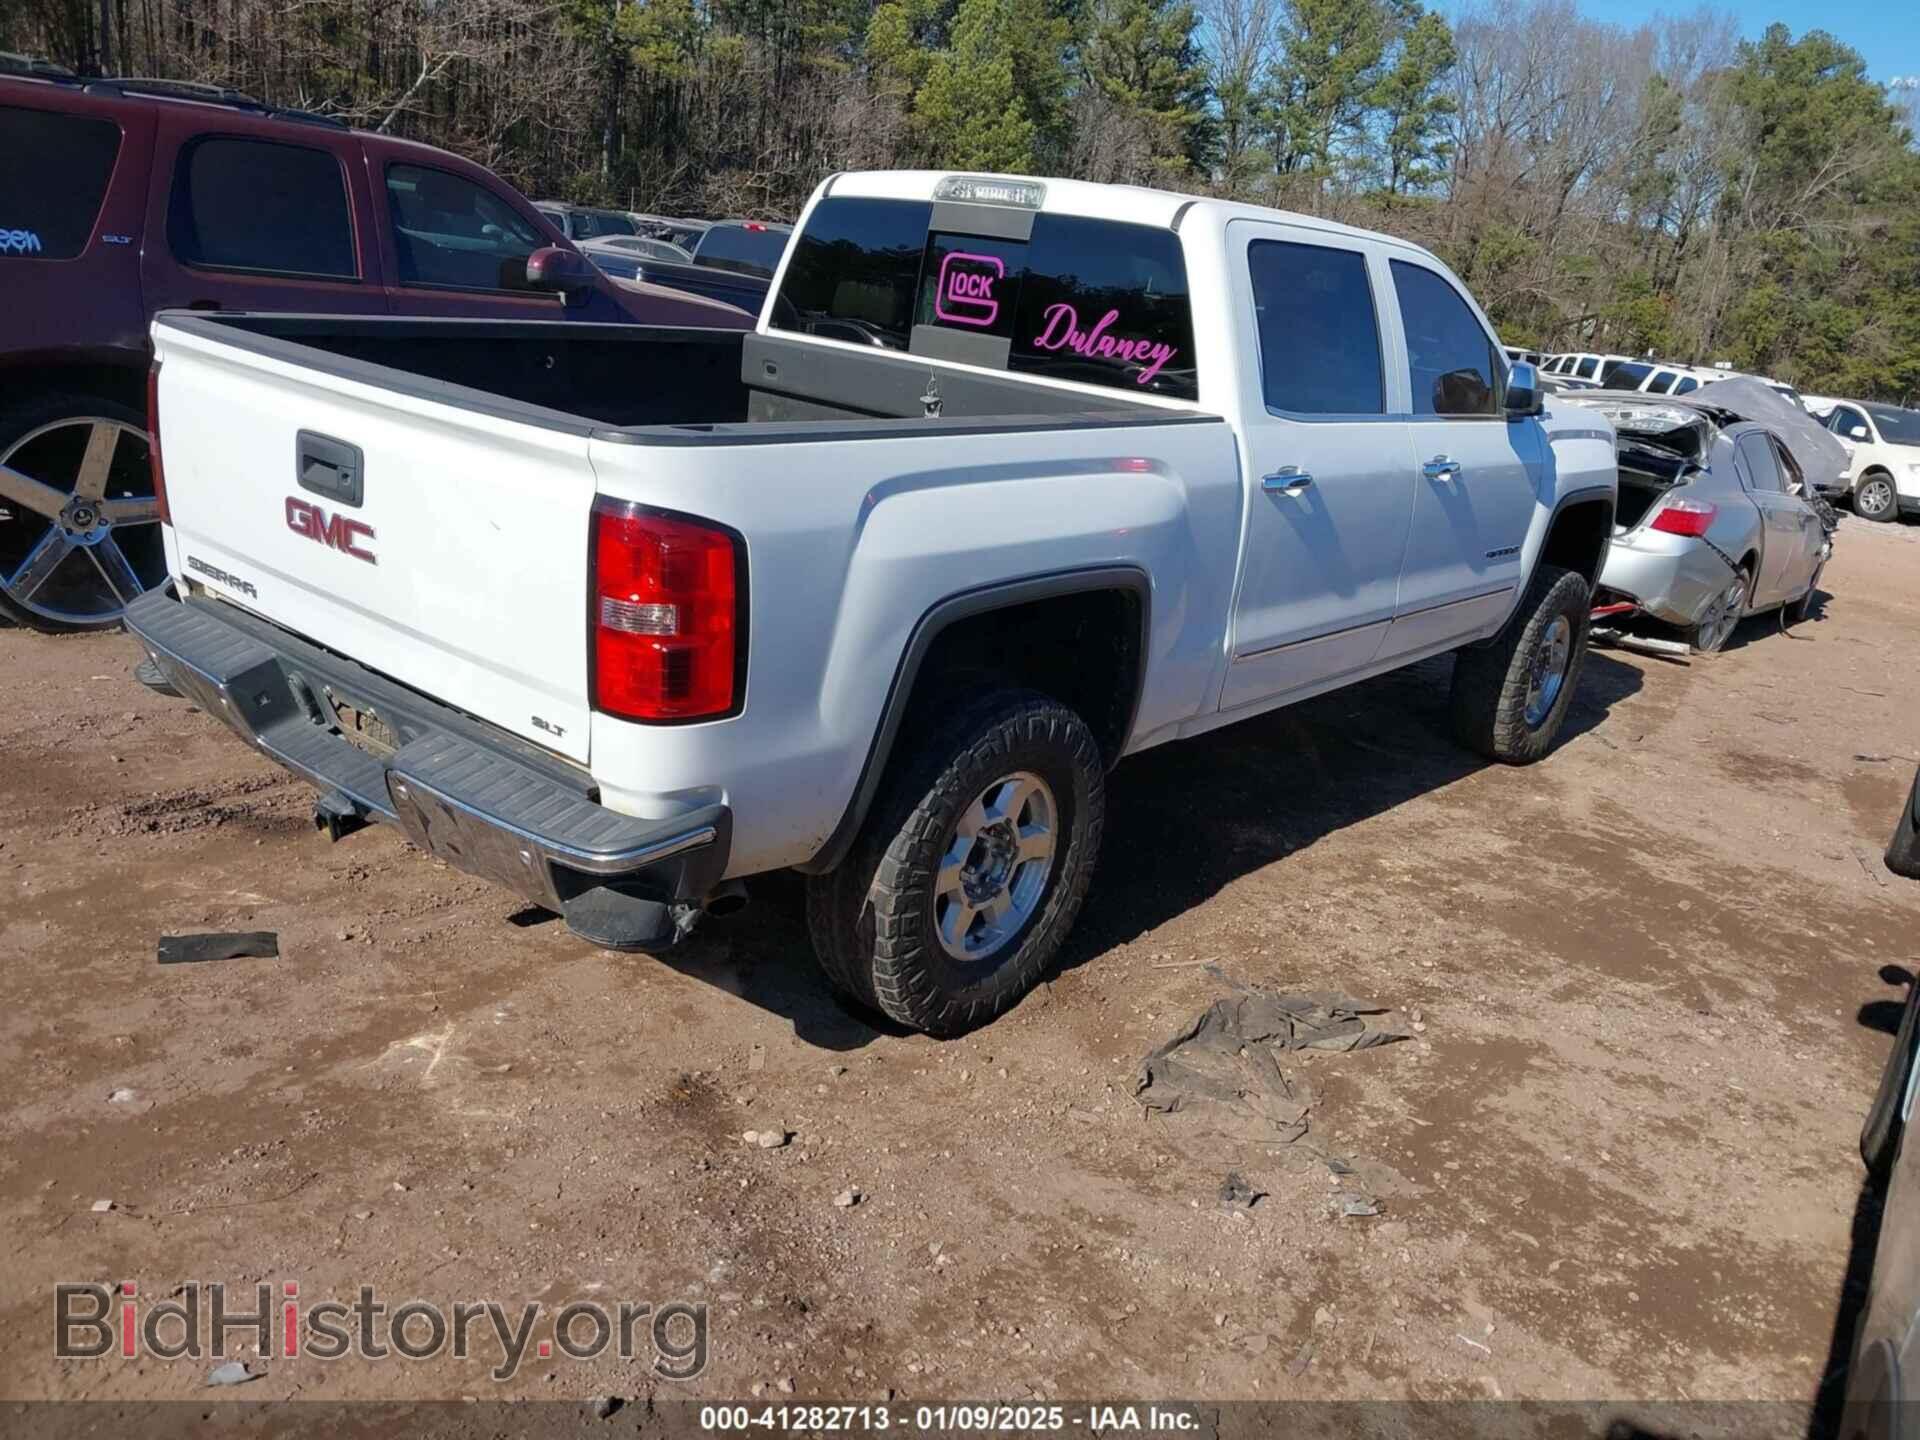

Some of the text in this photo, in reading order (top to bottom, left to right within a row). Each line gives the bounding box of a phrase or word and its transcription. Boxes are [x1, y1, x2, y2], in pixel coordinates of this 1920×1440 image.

[1033, 303, 1178, 385] Dulaney
[285, 495, 379, 566] GMC
[187, 554, 258, 600] SIERRA
[531, 715, 567, 737] SLT
